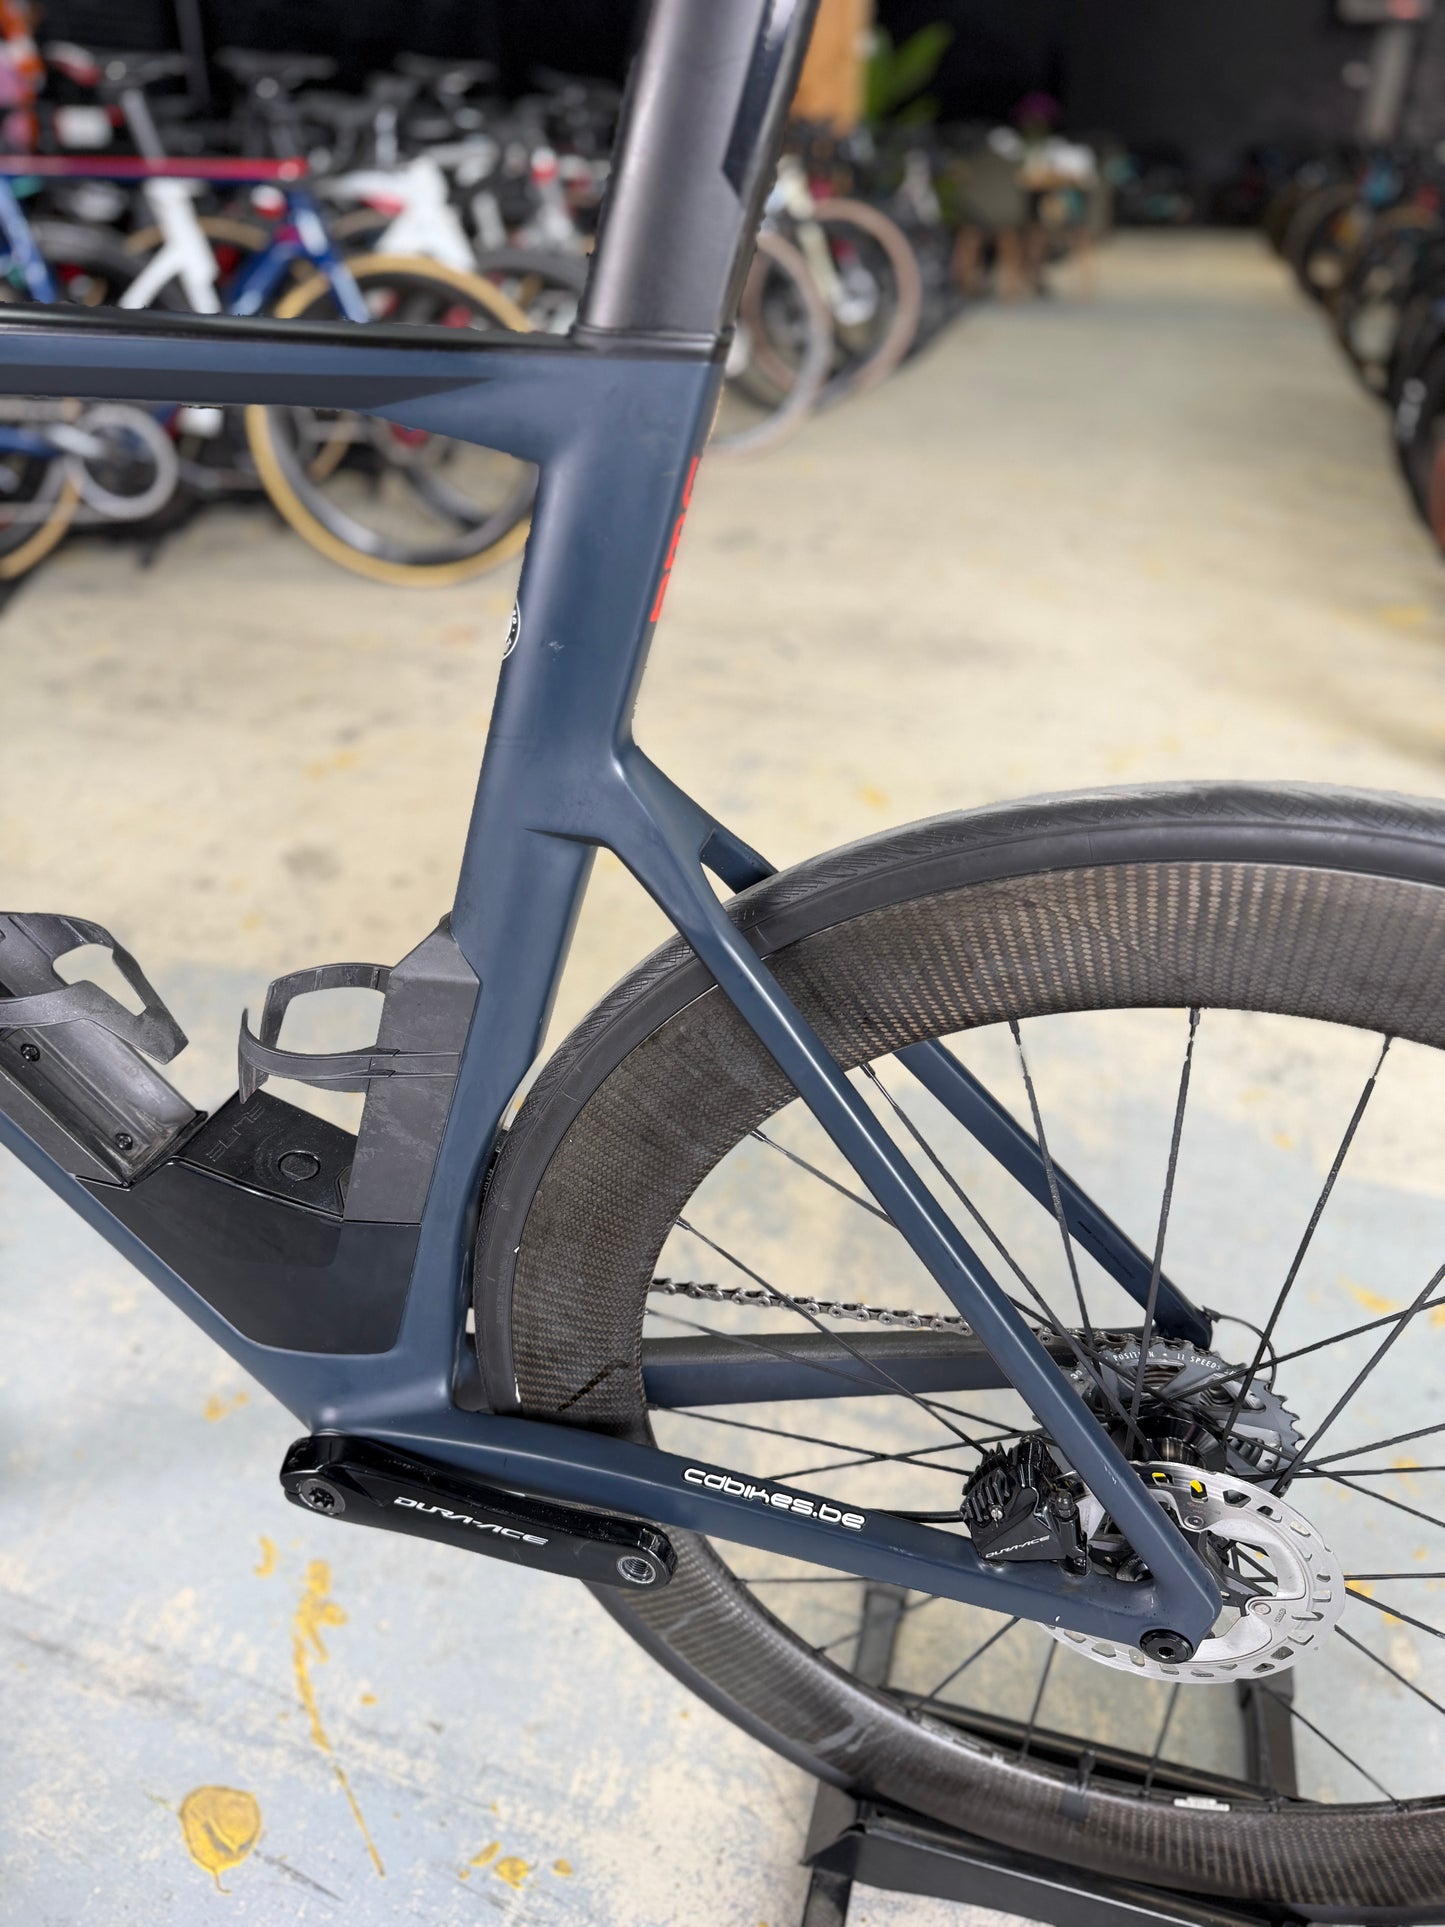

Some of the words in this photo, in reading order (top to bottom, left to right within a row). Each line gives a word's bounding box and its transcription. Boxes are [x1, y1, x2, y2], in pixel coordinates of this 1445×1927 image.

[1112, 1351, 1154, 1362] POSITN
[393, 1496, 549, 1545] DURA-ACE
[985, 1535, 1050, 1558] DURA-ACE
